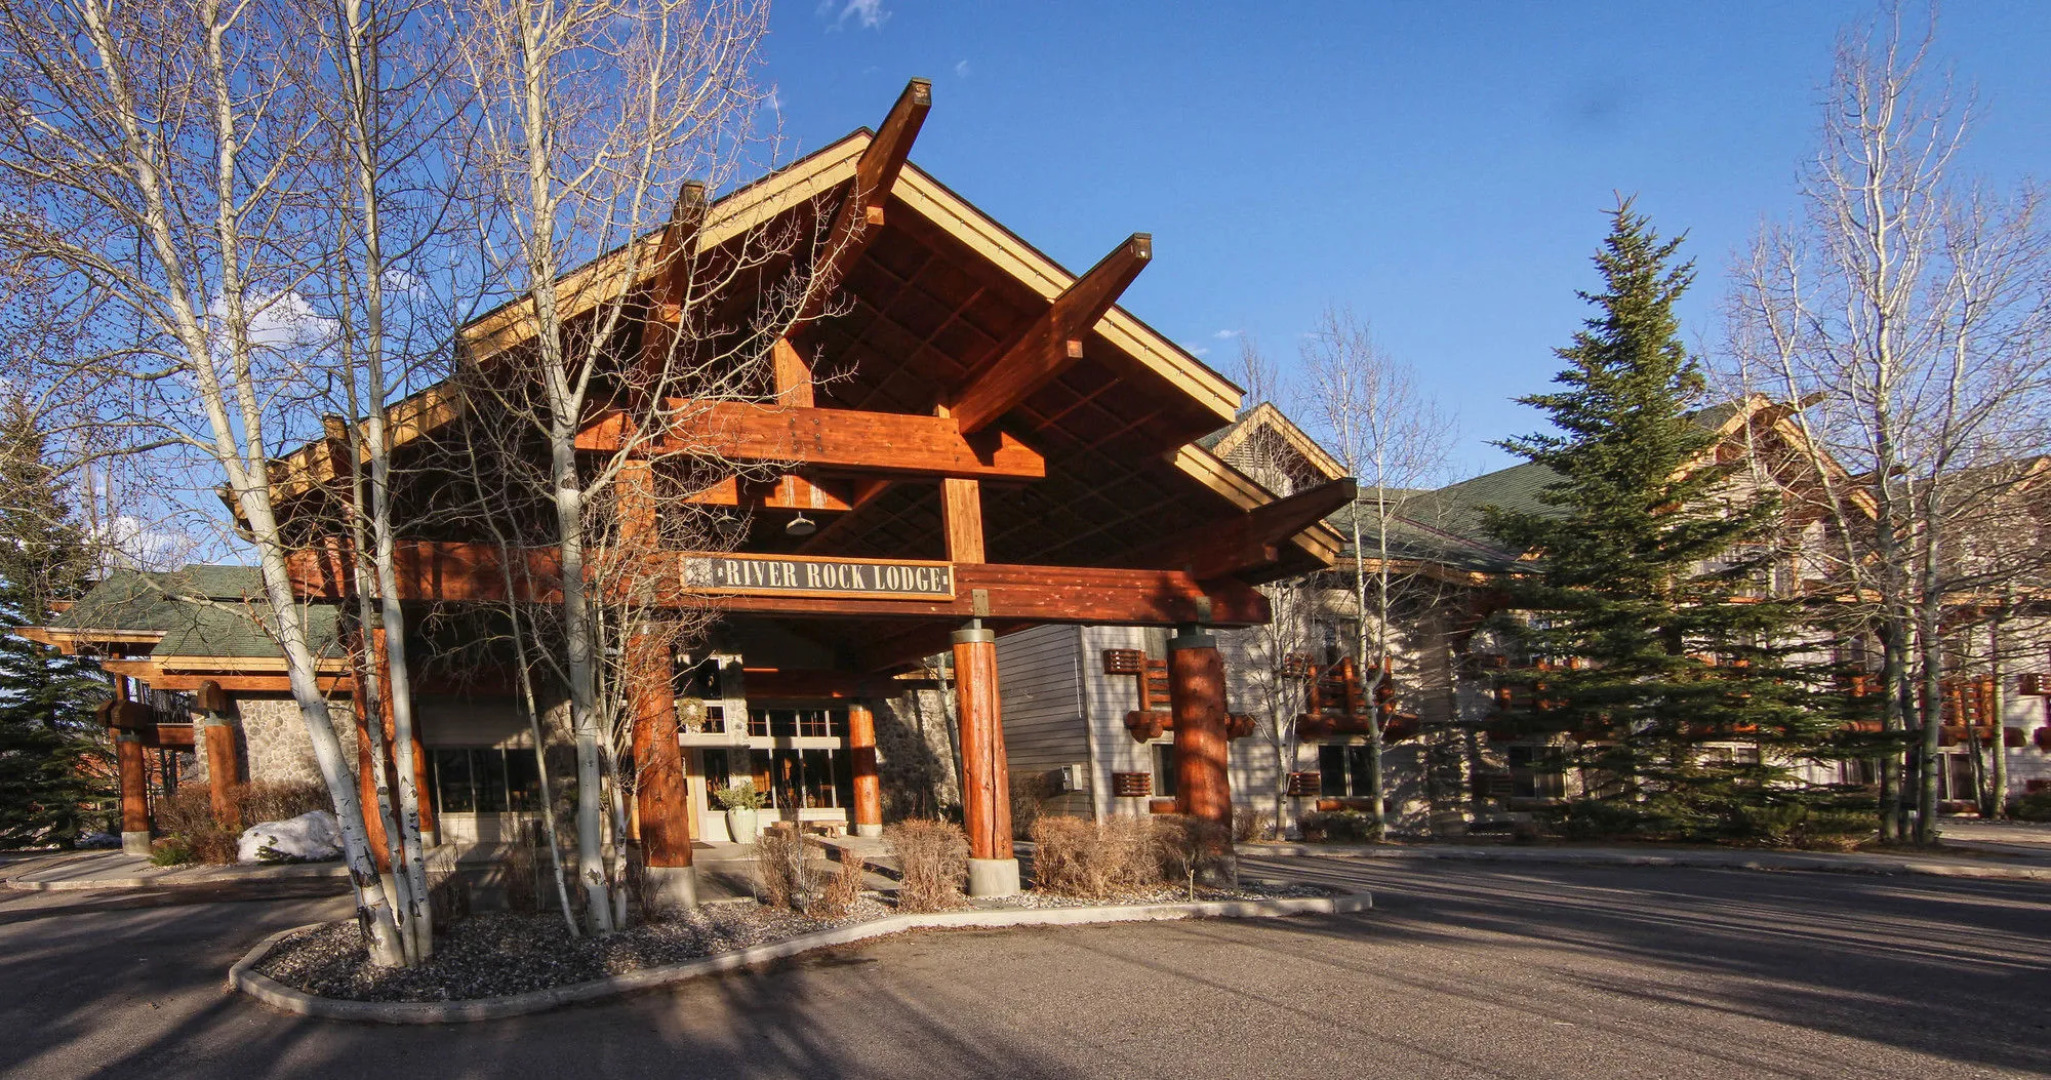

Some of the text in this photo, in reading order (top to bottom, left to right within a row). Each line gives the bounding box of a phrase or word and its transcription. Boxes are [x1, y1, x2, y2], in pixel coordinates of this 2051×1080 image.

[724, 559, 942, 592] RIVER ROCK LODGE
